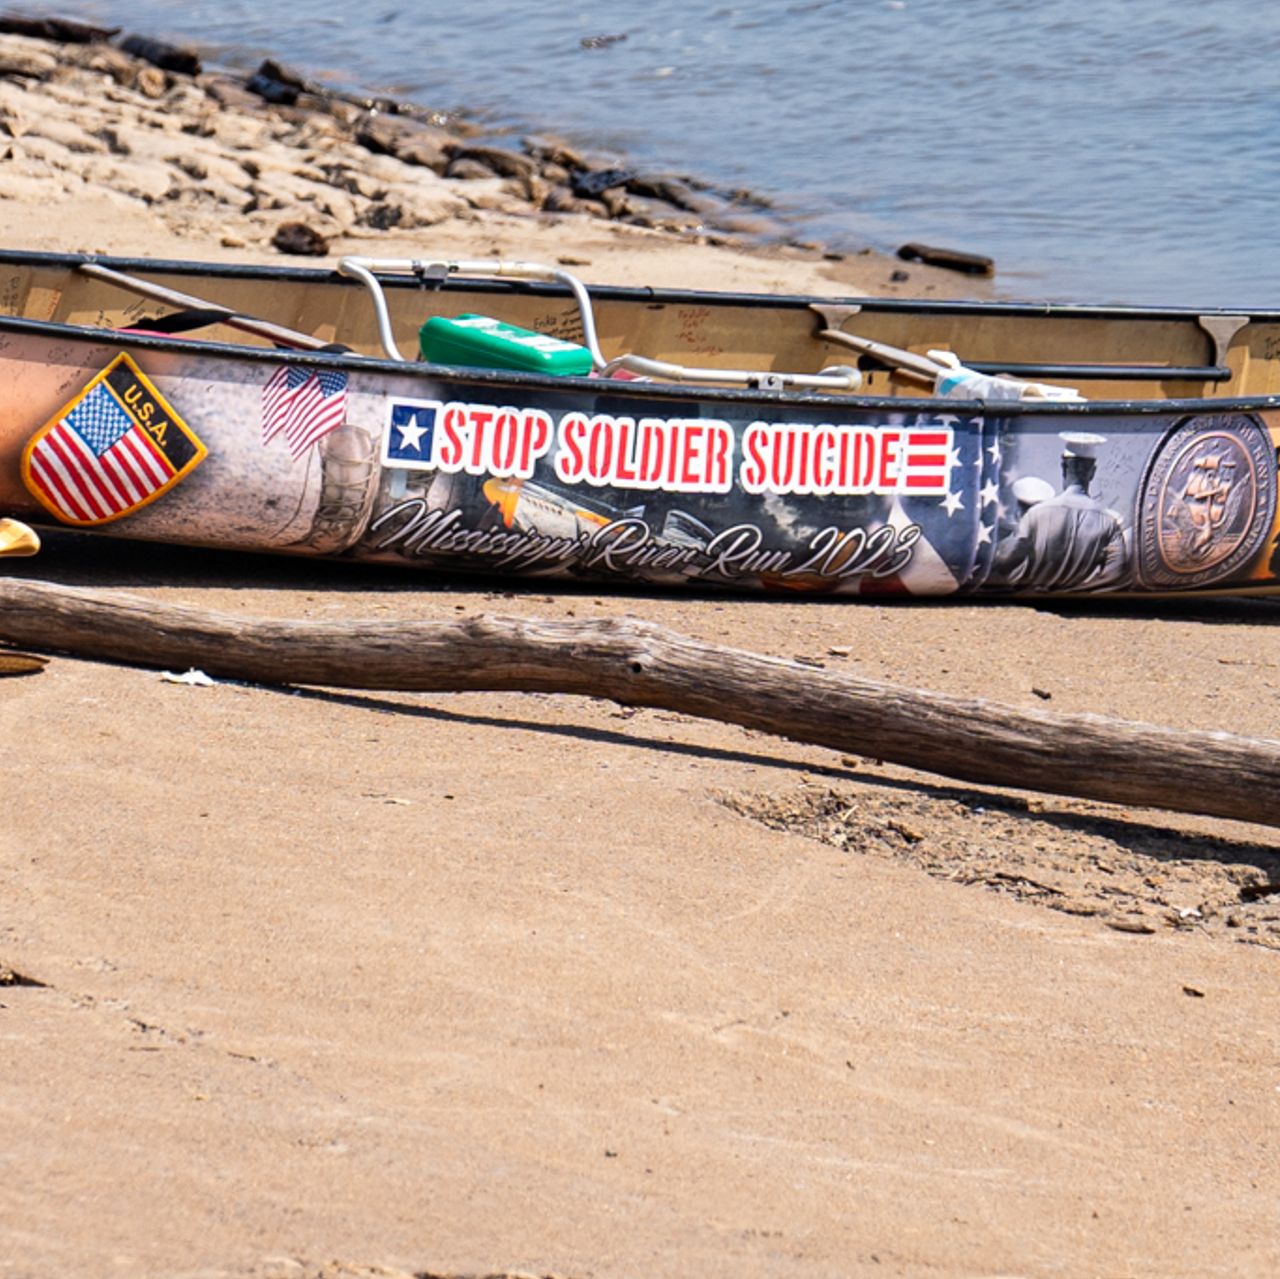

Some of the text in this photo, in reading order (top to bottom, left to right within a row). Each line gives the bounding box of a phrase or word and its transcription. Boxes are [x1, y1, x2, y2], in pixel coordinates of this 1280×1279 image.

[124, 384, 168, 447] U.S.A.
[439, 408, 901, 488] STOP SOLDIER SUICIDE
[1252, 445, 1269, 490] NAVY
[370, 498, 921, 579] Mississippi River Run 2023
